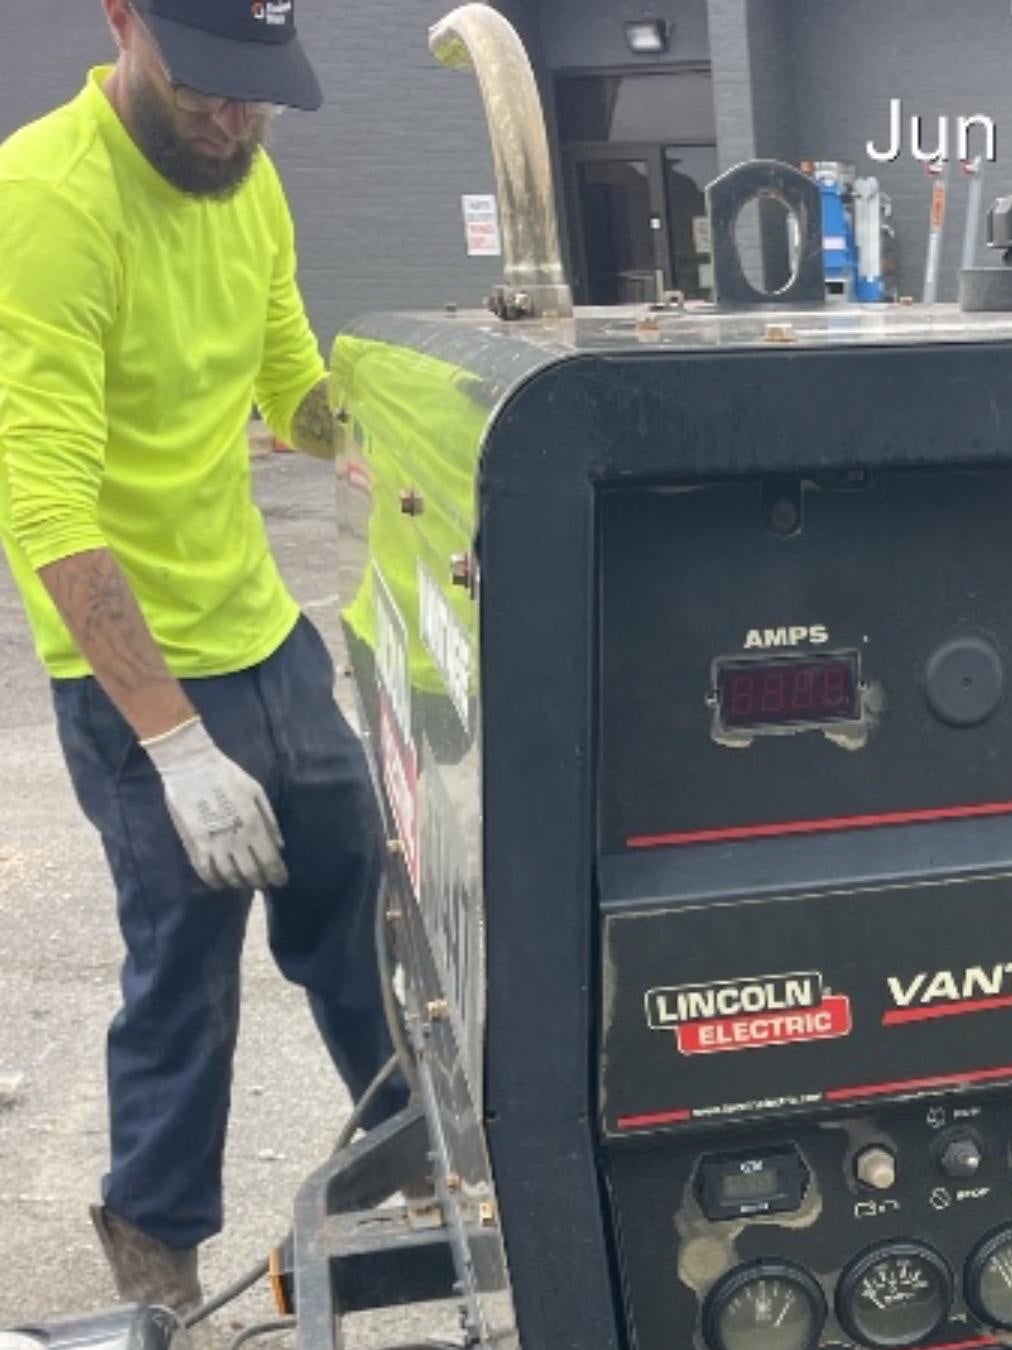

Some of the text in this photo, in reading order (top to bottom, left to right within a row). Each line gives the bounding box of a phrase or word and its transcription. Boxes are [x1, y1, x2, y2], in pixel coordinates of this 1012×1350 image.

[743, 624, 829, 650] AMPS
[656, 978, 813, 1023] LINCOLN
[697, 1012, 833, 1047] ELECTRIC
